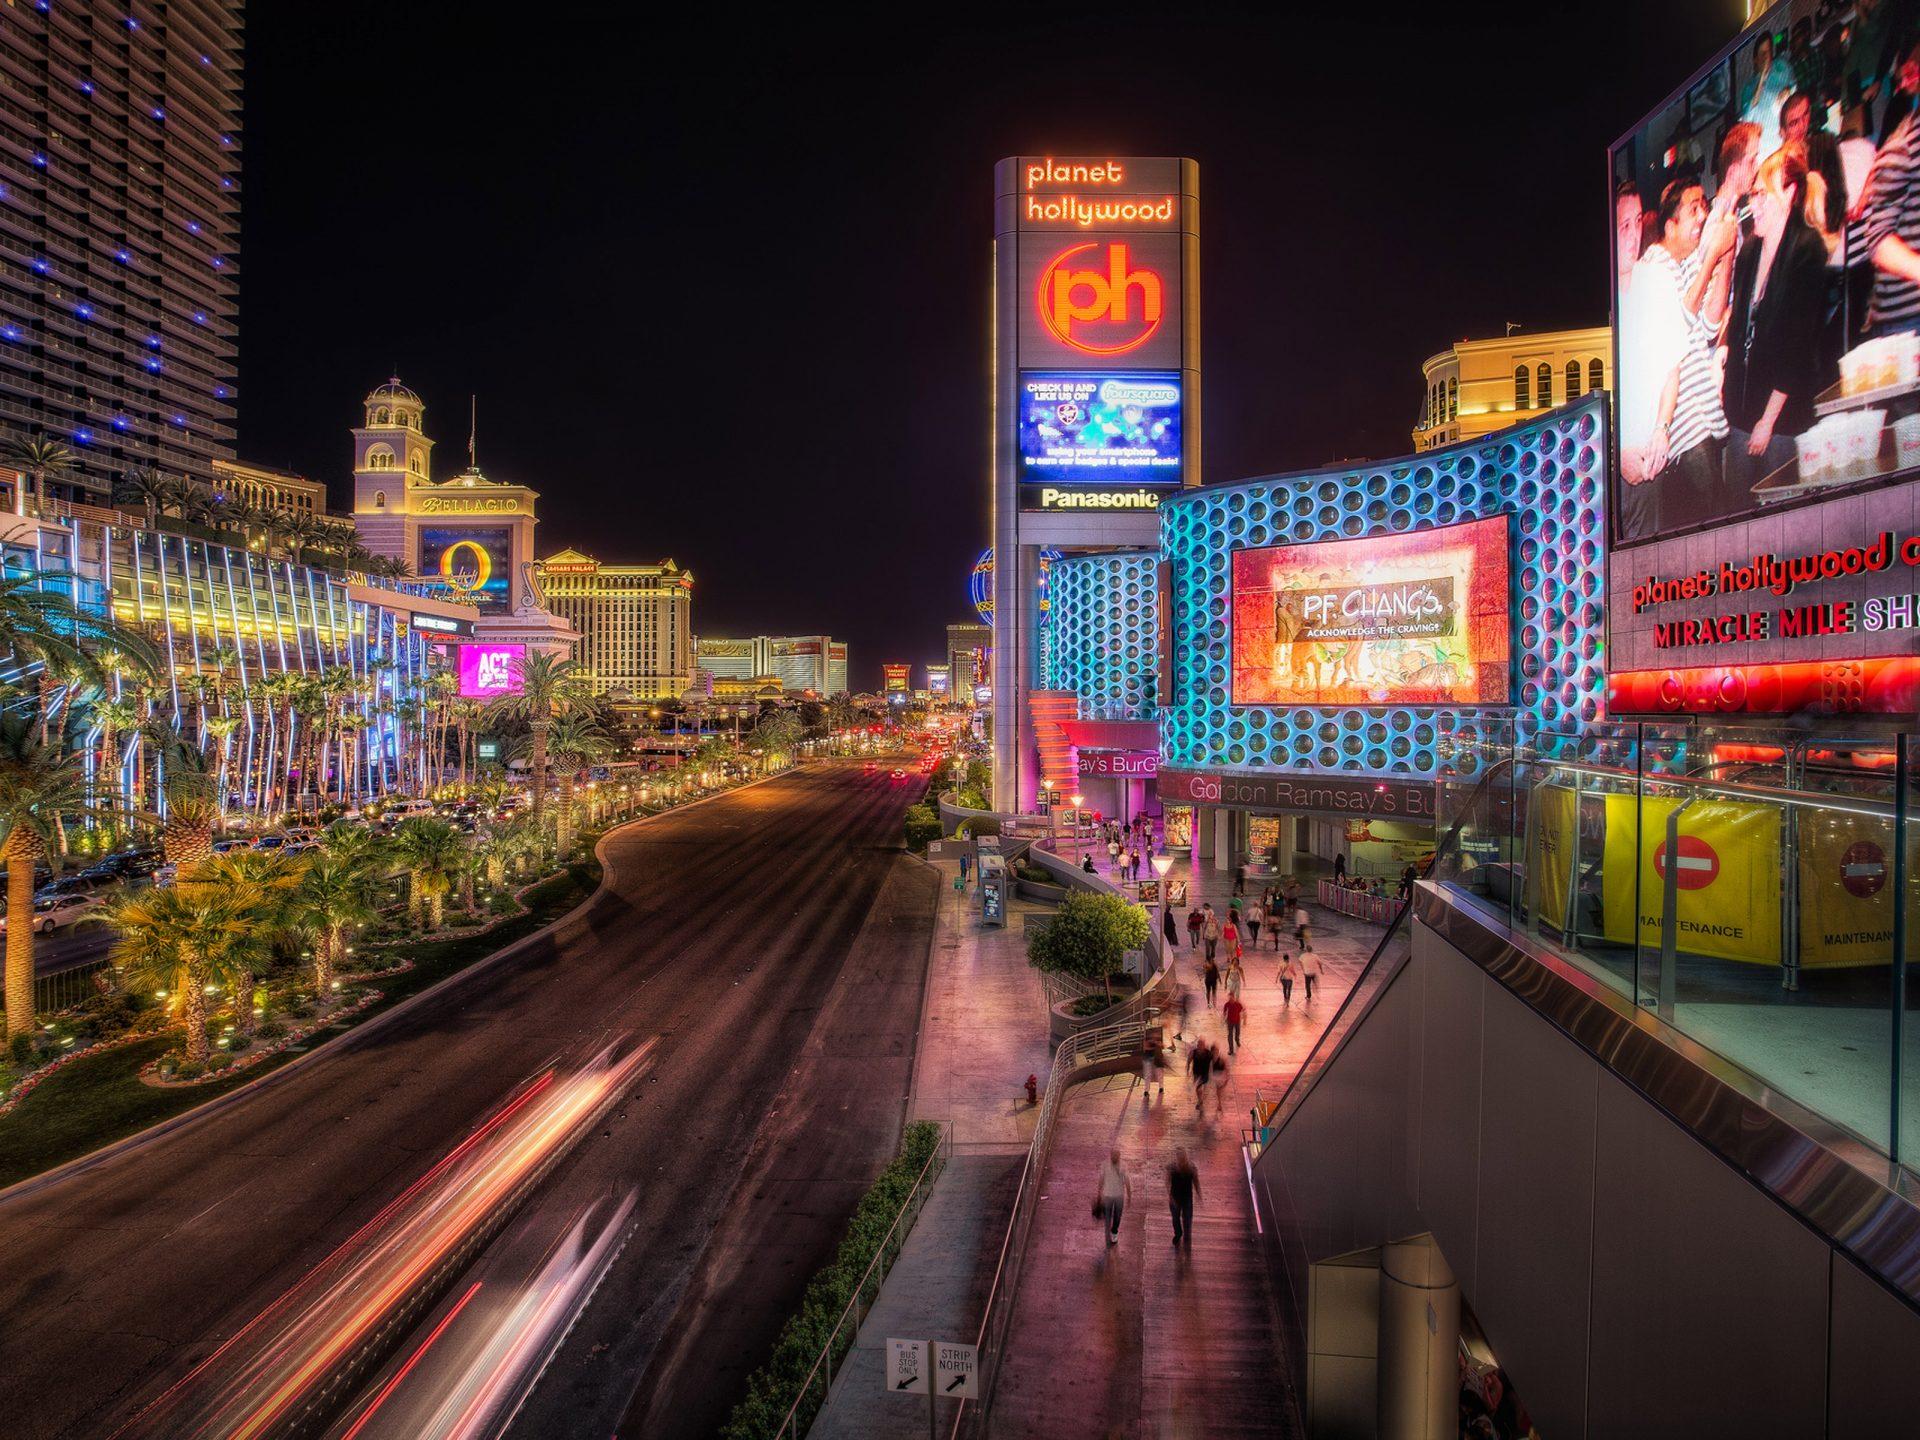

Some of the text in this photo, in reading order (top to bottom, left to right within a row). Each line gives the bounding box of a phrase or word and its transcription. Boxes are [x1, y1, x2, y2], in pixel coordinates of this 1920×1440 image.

[1026, 159, 1123, 188] planet
[1026, 196, 1172, 225] hollywood
[1053, 244, 1161, 337] ph
[1027, 383, 1097, 392] CHECK IN AND
[1035, 392, 1089, 401] LIKE US ON
[1104, 384, 1177, 402] foursquare
[422, 498, 518, 512] BELLAGIO
[1042, 488, 1159, 507] Panasonic
[1633, 570, 1715, 613] planet
[1720, 532, 1889, 596] hollywood
[1303, 594, 1338, 625] P.F.
[1654, 594, 1920, 649] MIRACLE MILE SH
[1307, 627, 1376, 637] ACKNOWLEDGE
[1378, 626, 1395, 634] THE
[479, 653, 511, 673] ACT
[1190, 776, 1267, 803] Gordon
[1276, 782, 1397, 818] Ramsay's
[898, 1359, 918, 1367] STOP
[900, 1350, 917, 1359] BUS
[941, 1348, 971, 1360] STRIP
[898, 1367, 918, 1375] ONLY
[939, 1360, 972, 1372] NORTH
